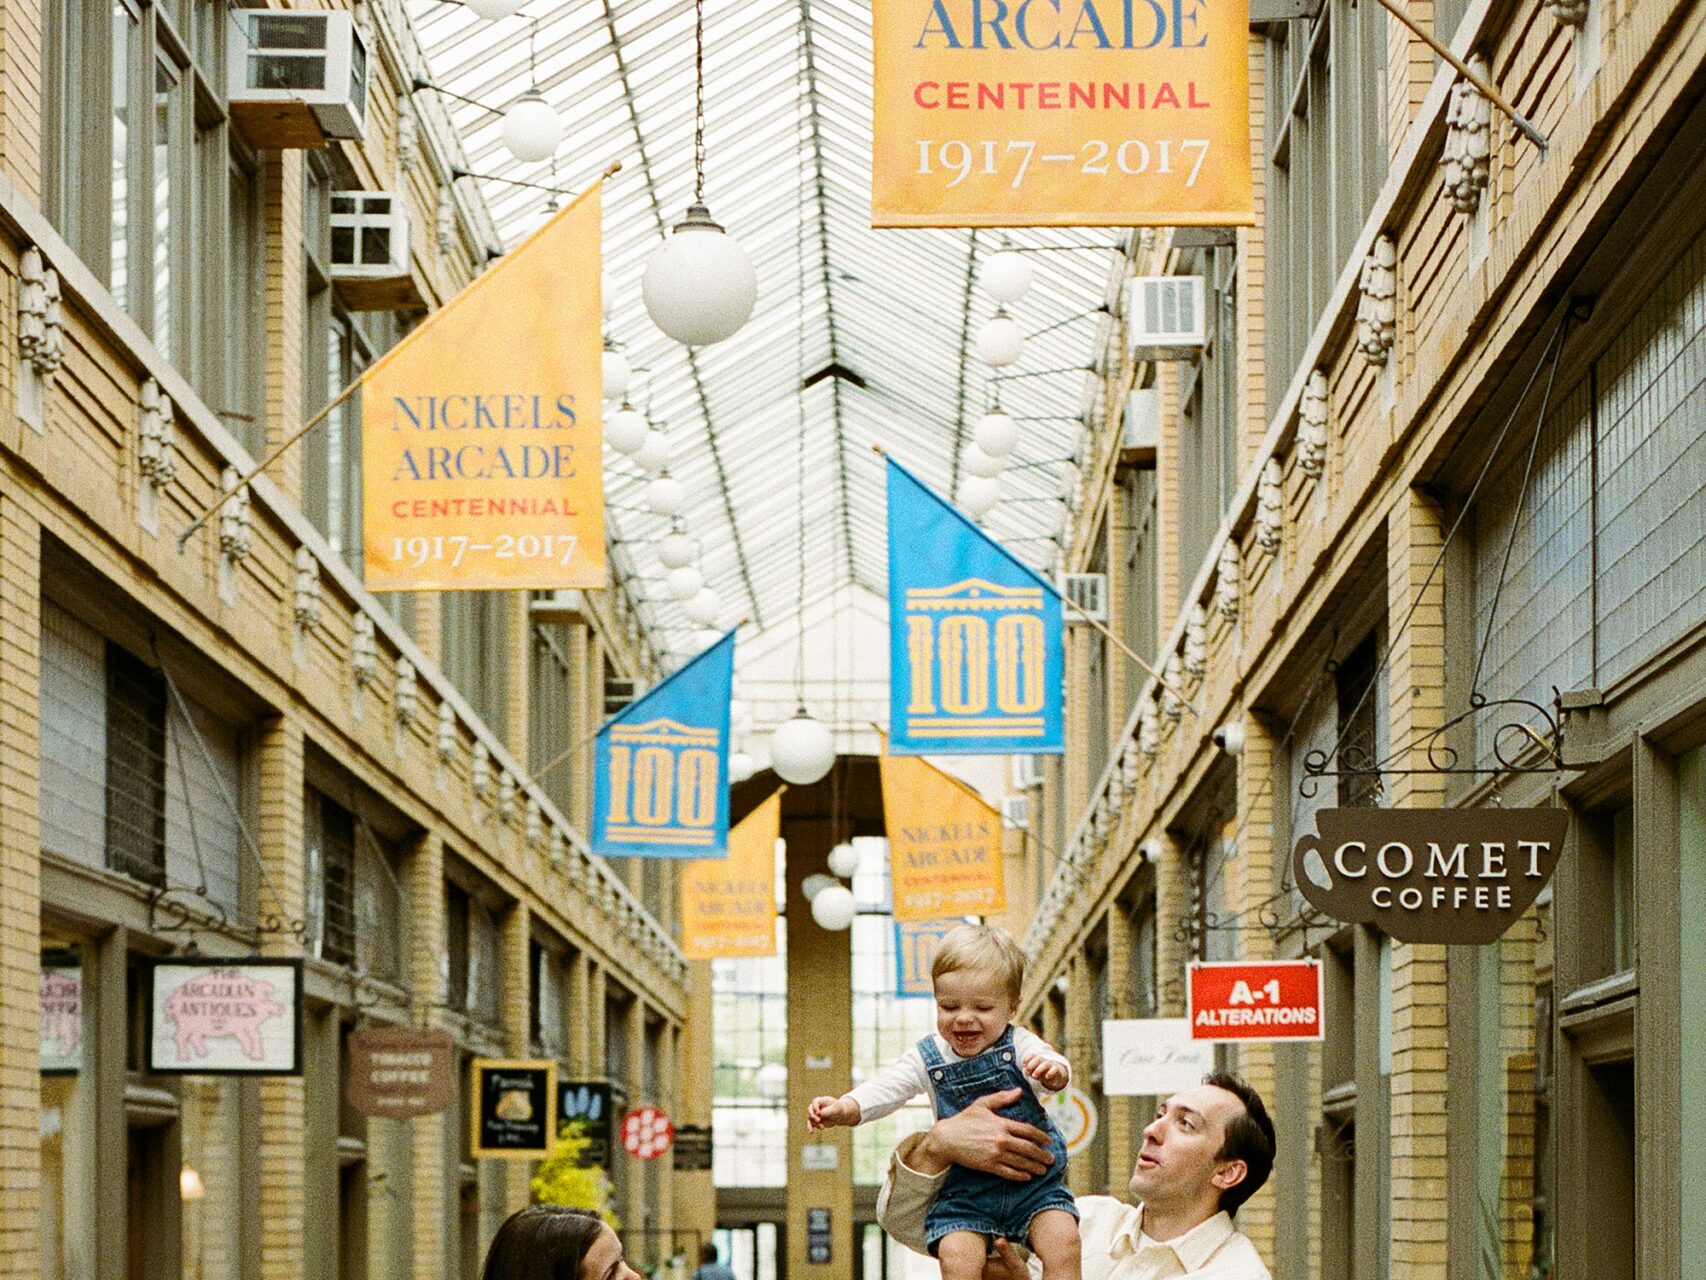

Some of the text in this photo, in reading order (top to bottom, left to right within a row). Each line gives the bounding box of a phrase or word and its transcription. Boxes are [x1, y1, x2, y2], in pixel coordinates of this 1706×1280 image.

[913, 0, 1209, 50] ARCADE
[913, 80, 1211, 110] CENTENNIAL
[392, 393, 577, 431] NICKELS
[392, 444, 577, 481] ARCADE
[391, 497, 578, 519] CENTENNIAL
[905, 614, 1045, 715] 100
[606, 744, 719, 827] 100
[1333, 839, 1551, 879] COMET
[1370, 885, 1512, 910] COFFEE
[1229, 979, 1281, 1006] A-1
[179, 1002, 257, 1017] ANTIQUES
[1195, 1006, 1317, 1027] ALTERATIONS
